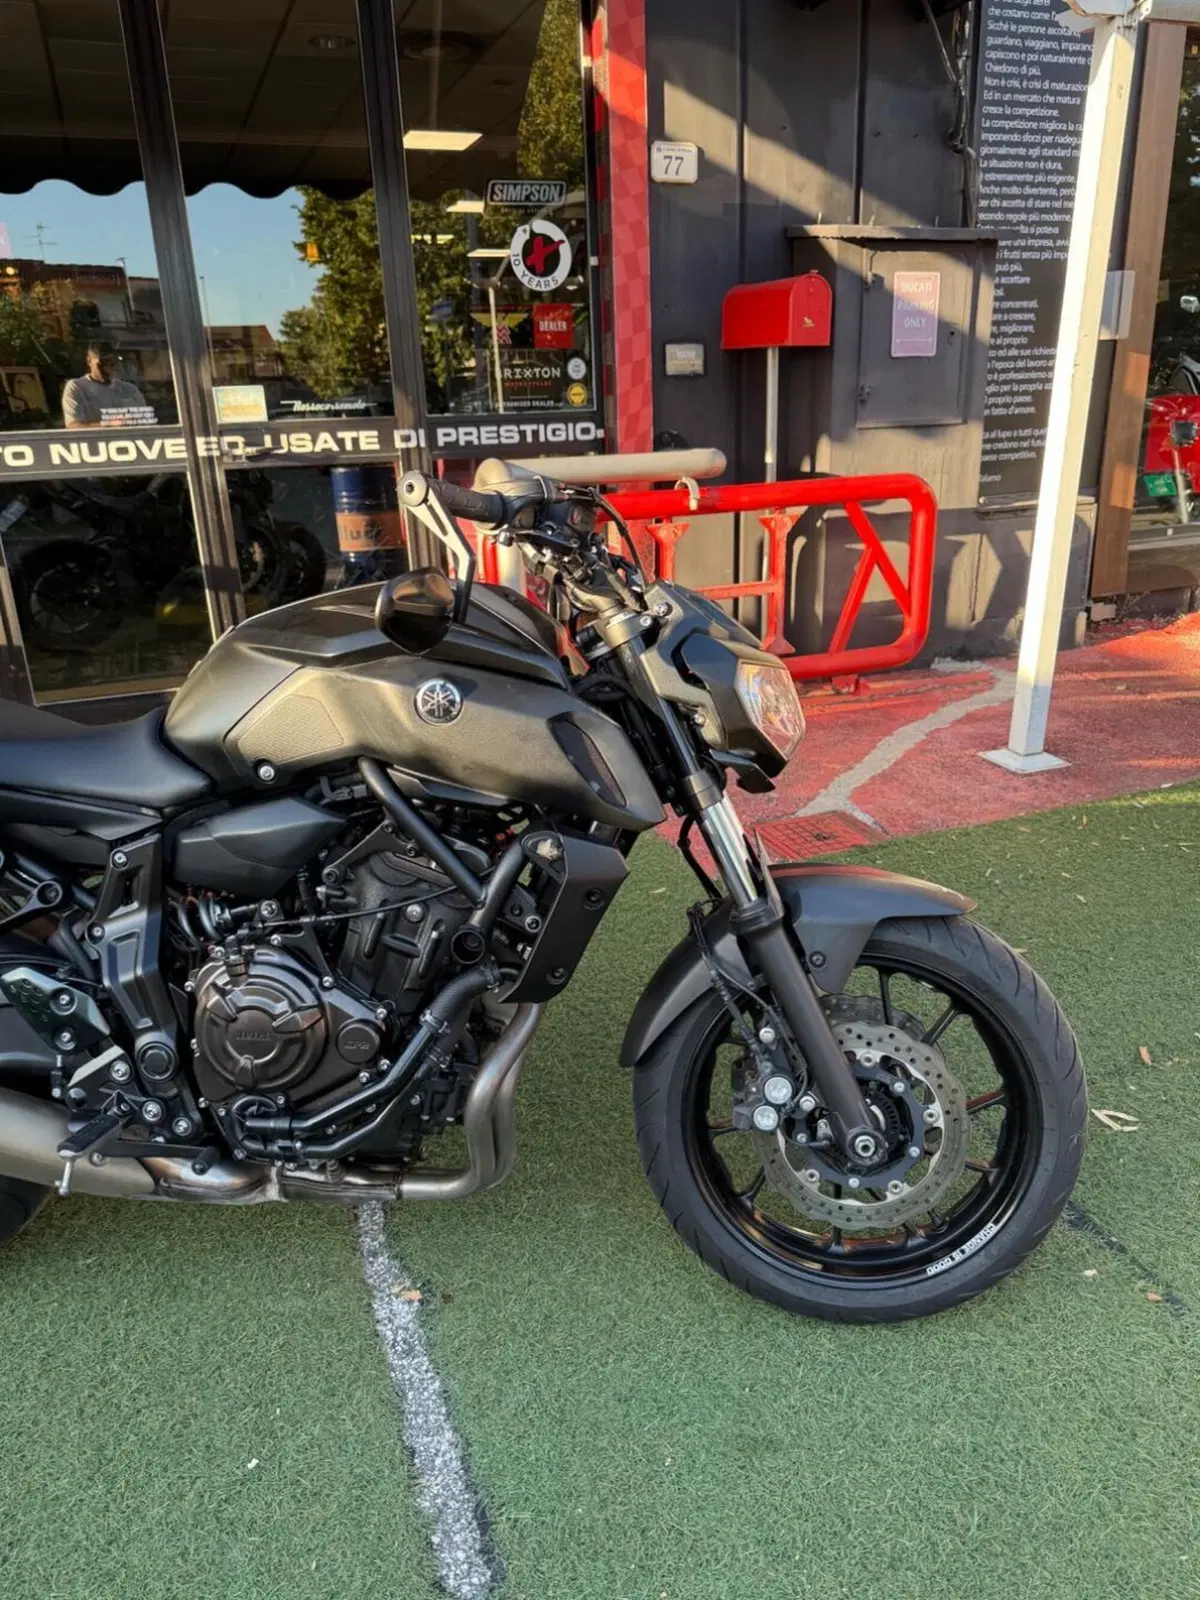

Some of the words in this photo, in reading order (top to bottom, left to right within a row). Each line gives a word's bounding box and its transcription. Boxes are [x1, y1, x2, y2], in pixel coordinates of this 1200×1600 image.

[663, 155, 684, 175] 77
[492, 184, 560, 201] SIMPSON
[520, 270, 559, 289] YEARS
[539, 320, 567, 332] DEALER
[500, 367, 560, 379] RIXTON
[0, 445, 34, 467] O
[50, 438, 188, 465] NUOVE
[263, 431, 380, 454] USATE
[394, 428, 426, 449] DI
[437, 422, 605, 447] PRESTIGIO.
